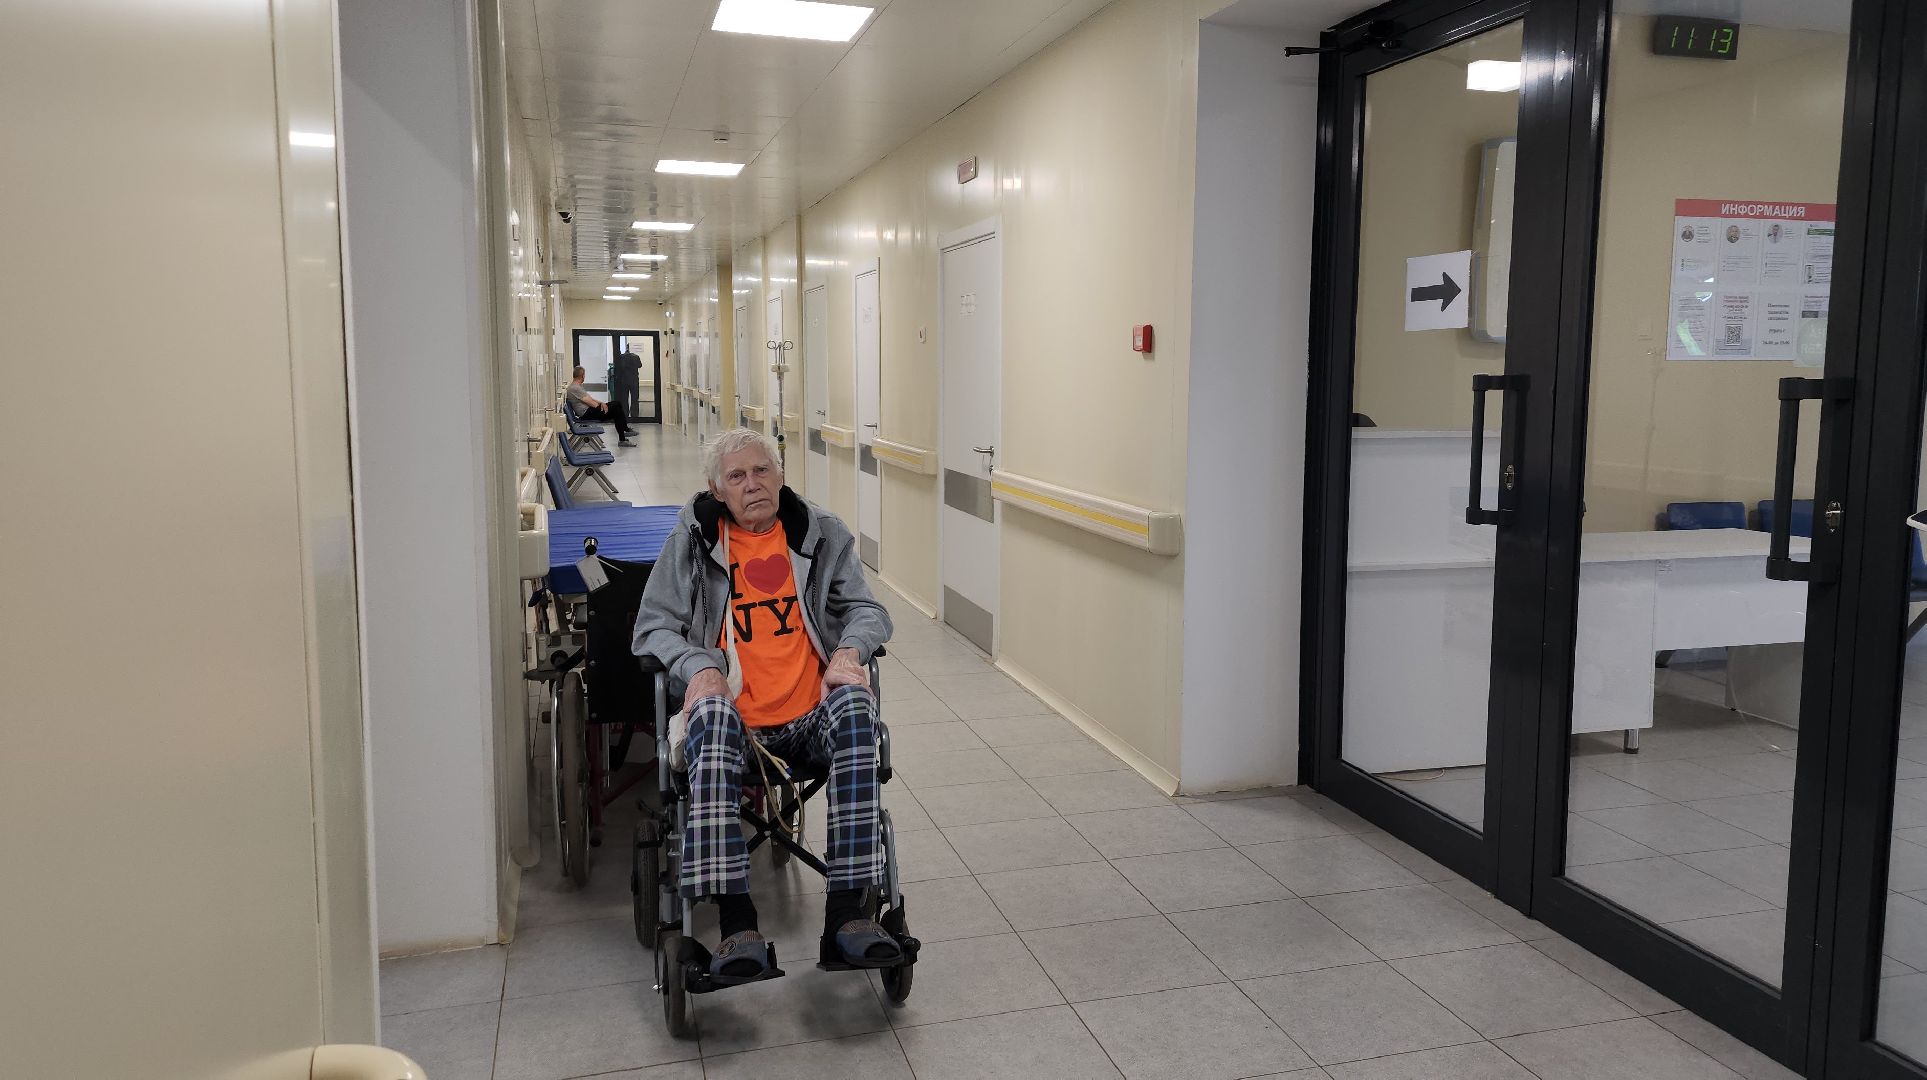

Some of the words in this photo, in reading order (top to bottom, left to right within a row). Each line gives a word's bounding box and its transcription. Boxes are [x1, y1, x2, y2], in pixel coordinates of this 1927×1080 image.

[1721, 203, 1806, 218] ИНФОРМАЦИЯ
[729, 562, 743, 600] I
[731, 596, 798, 643] NY
